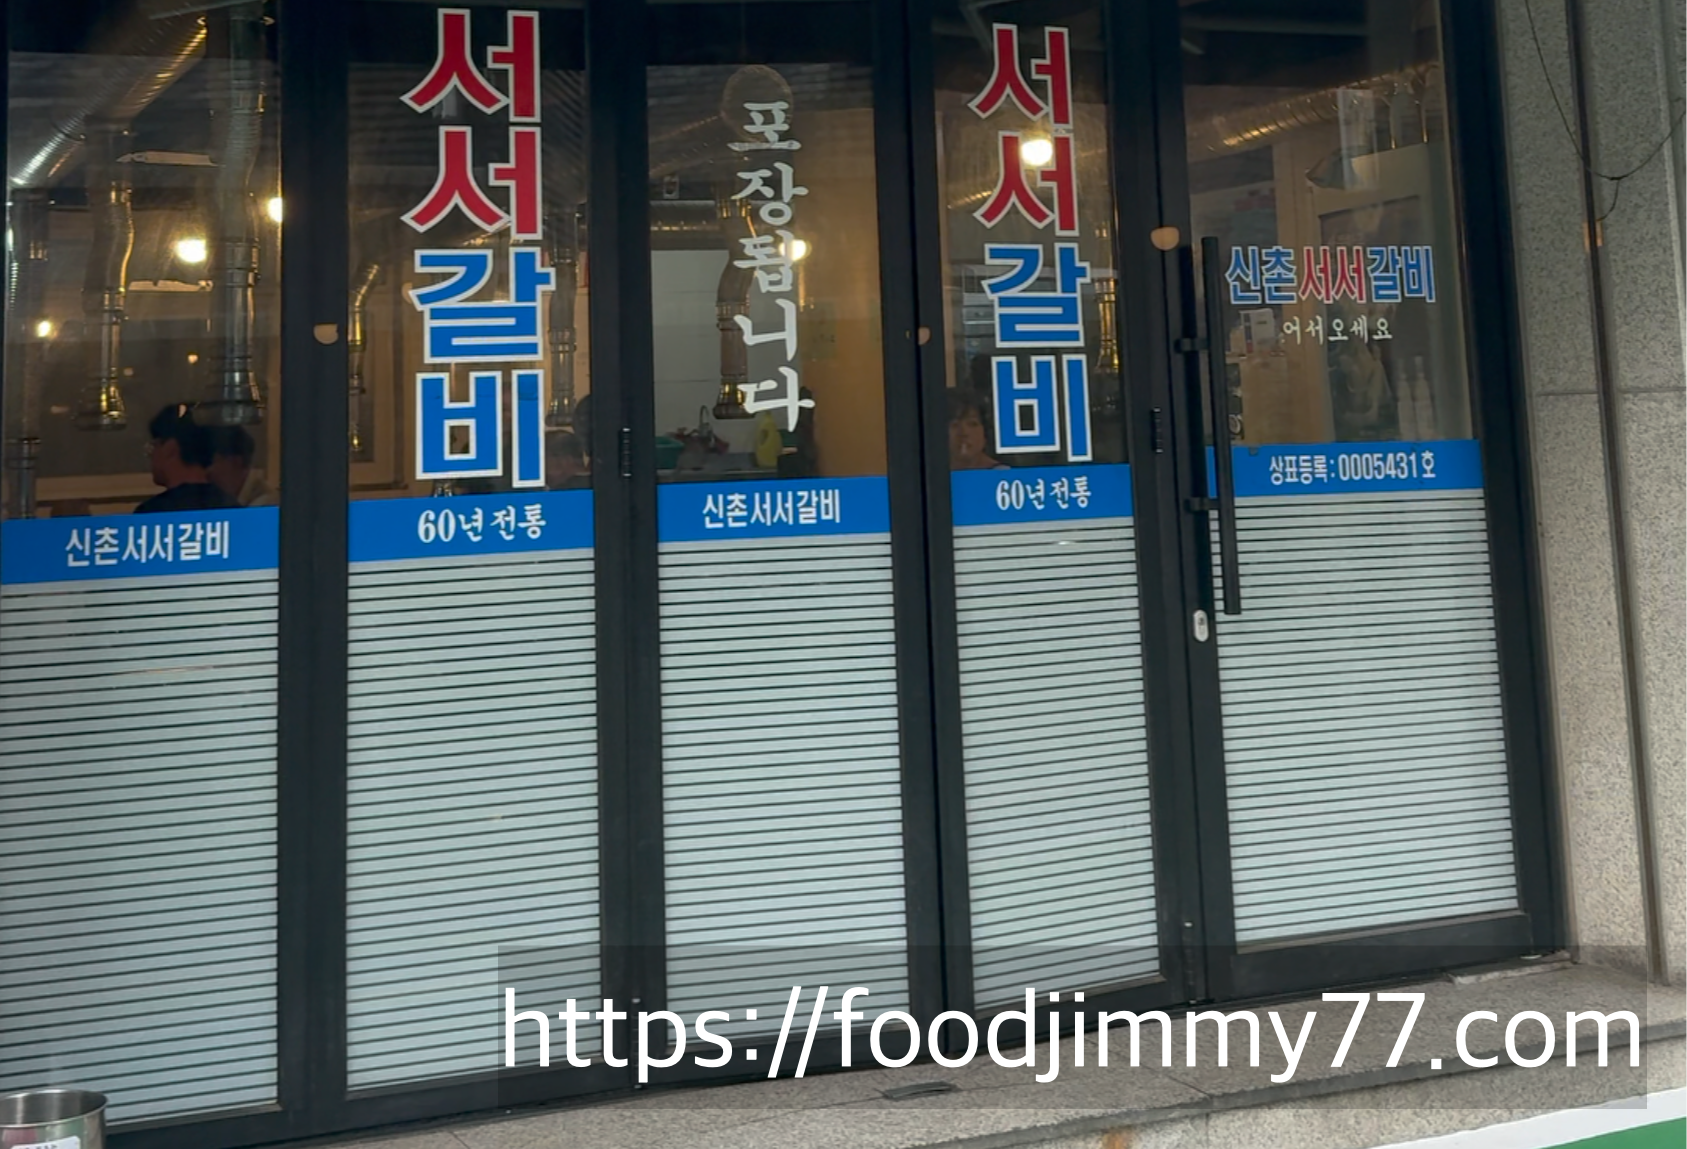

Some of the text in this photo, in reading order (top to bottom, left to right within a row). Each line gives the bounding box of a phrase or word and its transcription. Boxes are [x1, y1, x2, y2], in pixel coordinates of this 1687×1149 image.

[400, 8, 556, 488] 서서갈비
[727, 101, 816, 433] 포장됩니다
[968, 23, 1094, 462] 서서갈비
[1224, 245, 1437, 304] 신촌서서갈비
[1282, 315, 1393, 345] 어서오세요
[417, 503, 547, 544] 60년 전통
[702, 489, 841, 530] 신촌서서갈비
[65, 520, 230, 568] 신촌서서갈비
